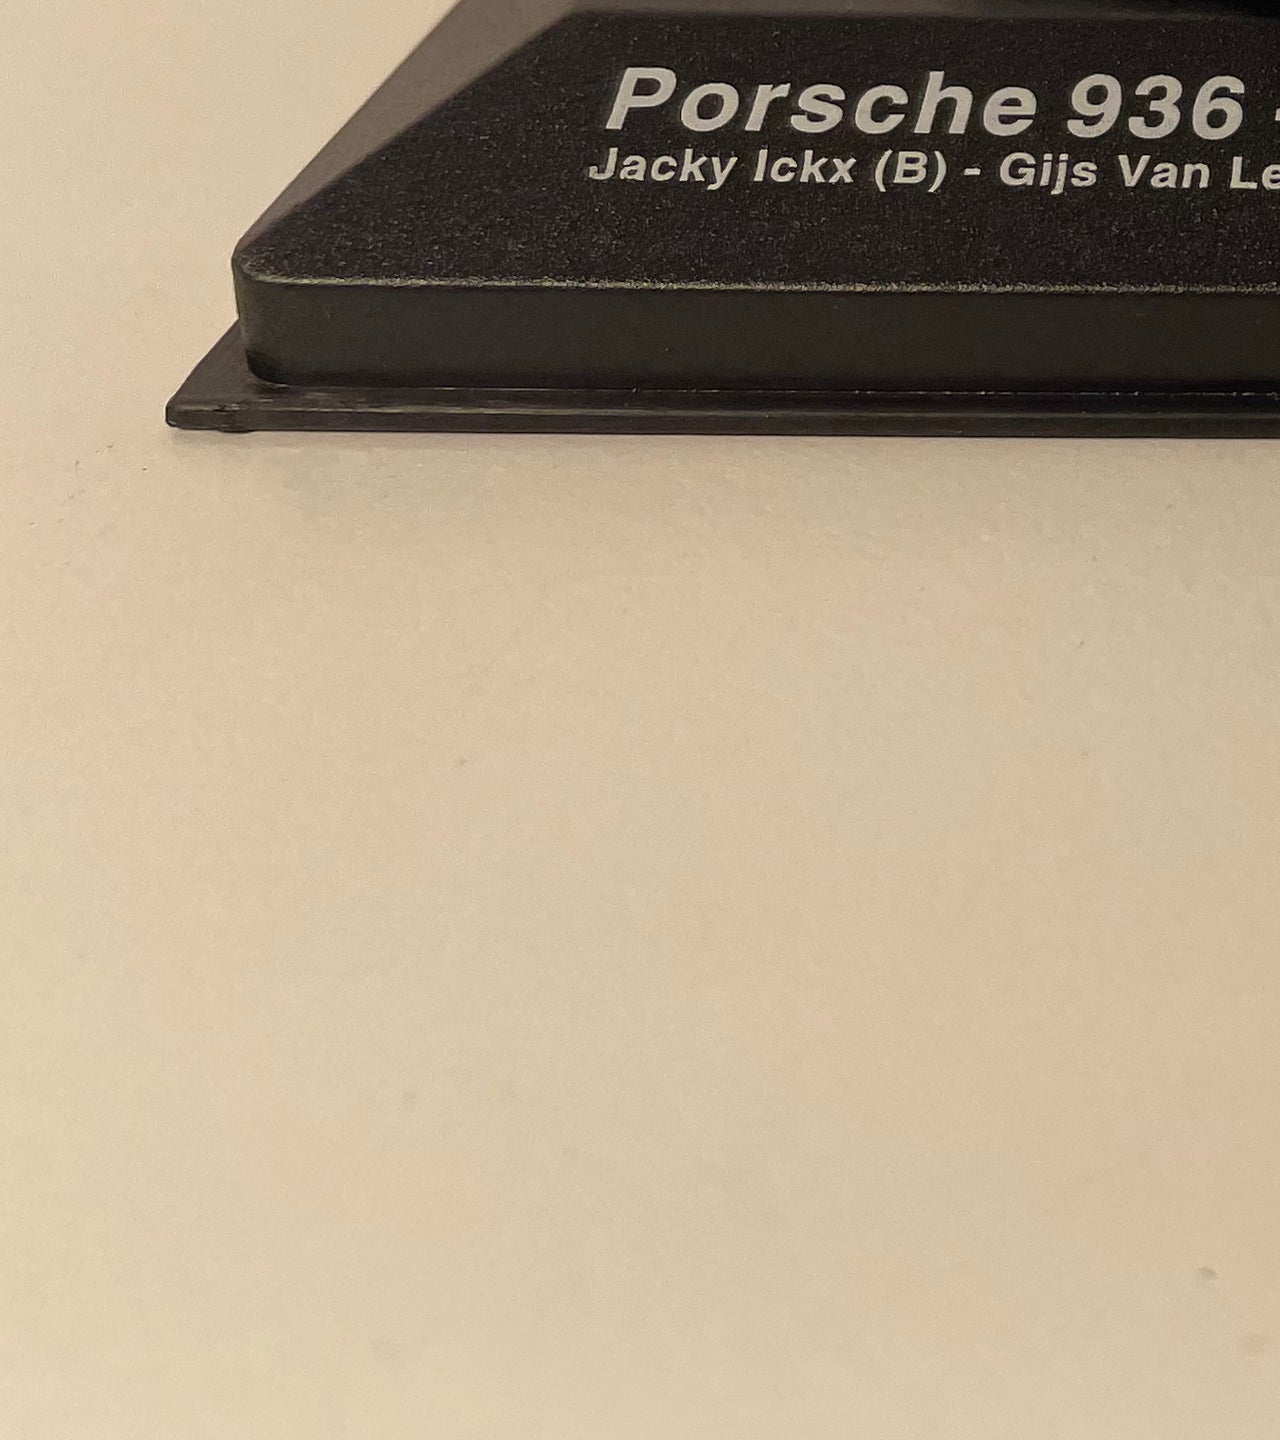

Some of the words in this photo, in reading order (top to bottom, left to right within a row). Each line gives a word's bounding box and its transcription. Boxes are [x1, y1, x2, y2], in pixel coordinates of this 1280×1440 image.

[605, 66, 1038, 137] Porsche
[1066, 73, 1246, 141] 936
[588, 146, 738, 190] Jacky
[752, 149, 857, 184] Ickx
[873, 148, 948, 193] (B)
[999, 152, 1098, 195] Gijs
[1117, 154, 1211, 190] Van
